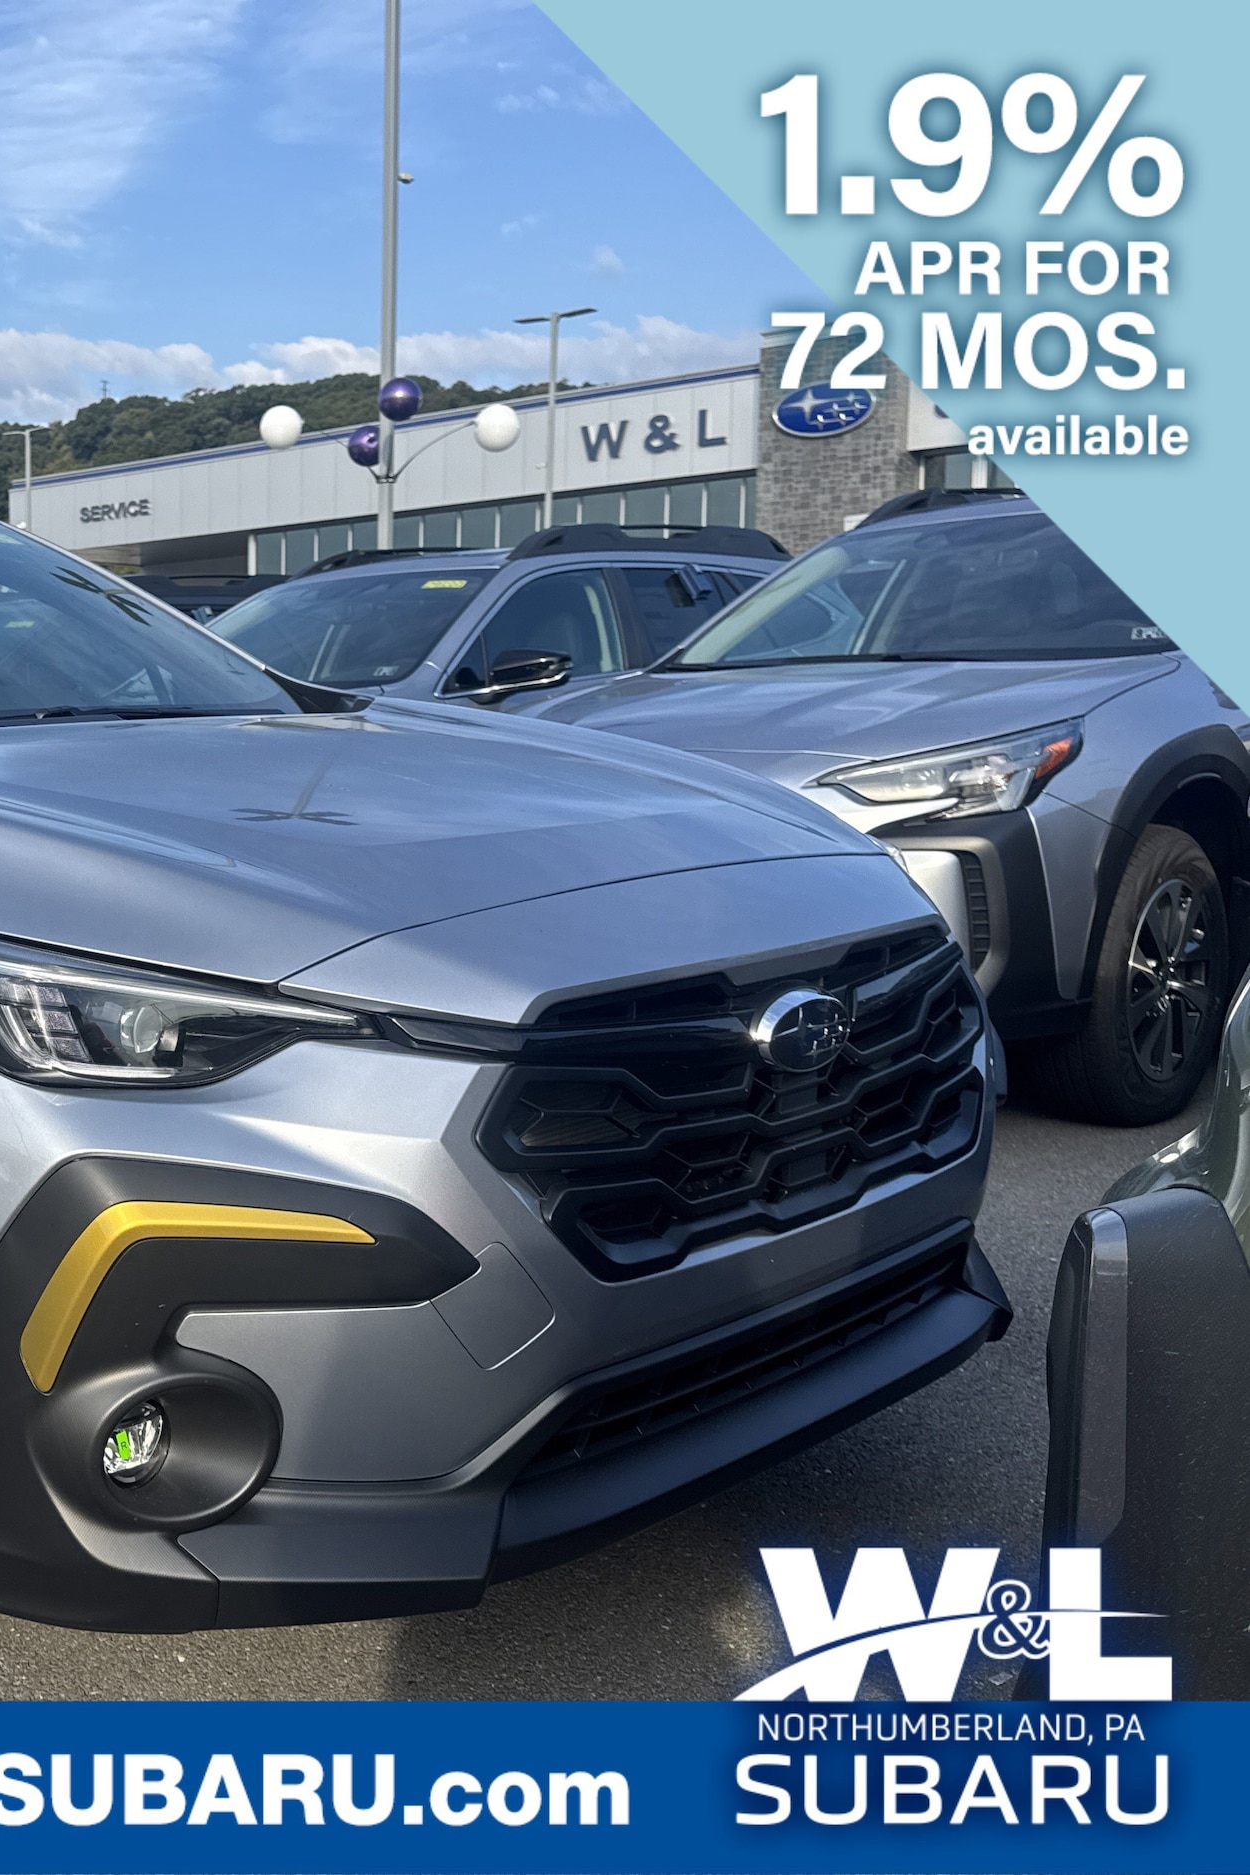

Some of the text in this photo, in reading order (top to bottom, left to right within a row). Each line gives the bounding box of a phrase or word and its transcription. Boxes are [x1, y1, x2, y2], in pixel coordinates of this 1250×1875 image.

[581, 409, 727, 462] W & L
[80, 499, 151, 523] SERVICE
